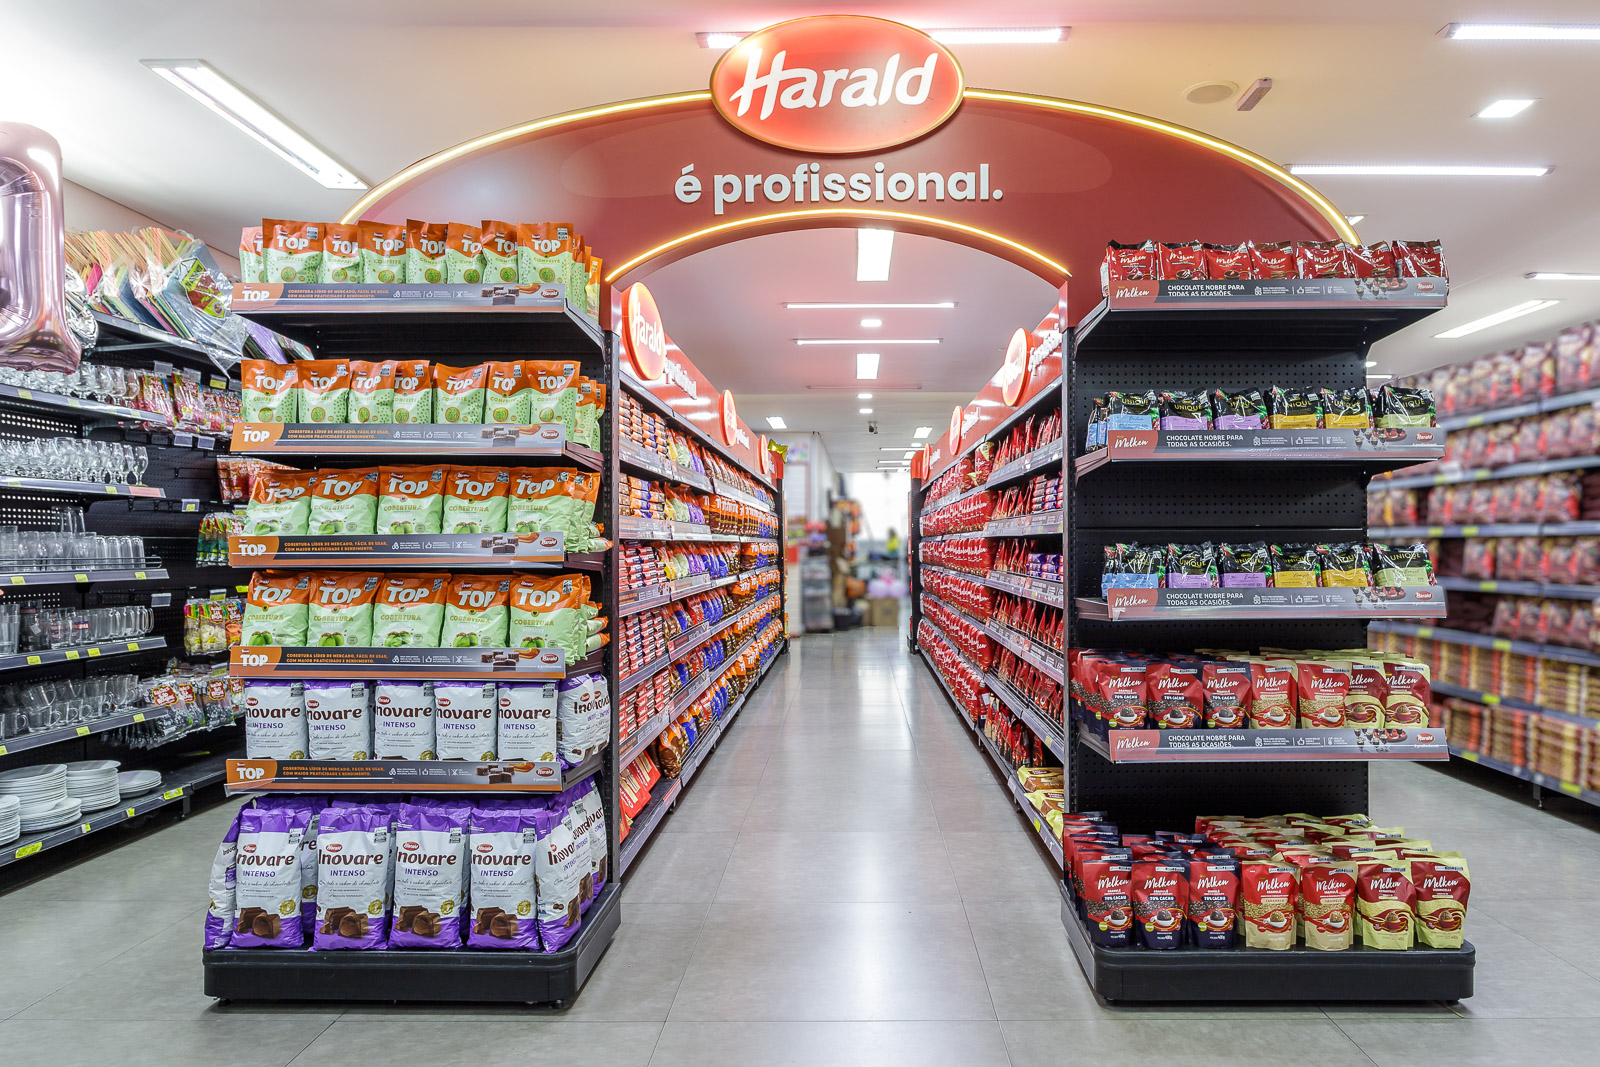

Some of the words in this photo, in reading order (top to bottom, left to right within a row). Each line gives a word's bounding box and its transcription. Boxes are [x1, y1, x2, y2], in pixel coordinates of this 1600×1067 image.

[729, 48, 938, 120] Harald
[675, 163, 701, 203] é
[714, 161, 1003, 215] profissional.
[276, 235, 309, 251] TOP
[372, 238, 405, 251] TOP
[531, 239, 561, 253] TOP
[241, 290, 270, 302] TOP
[1116, 287, 1149, 299] Melken
[254, 376, 286, 391] TOP
[310, 376, 337, 389] TOP
[355, 375, 382, 389] TOP
[394, 377, 419, 390] TOP
[446, 378, 474, 391] TOP
[492, 376, 516, 391] TOP
[538, 376, 567, 390] TOP
[242, 430, 270, 442] TOP
[1115, 436, 1149, 448] Melken
[321, 479, 363, 496] TOP
[388, 478, 429, 494] TOP
[454, 479, 495, 497] TOP
[516, 478, 555, 495] TOP
[265, 486, 306, 502] TOP
[448, 505, 489, 513] COBERTURA
[238, 544, 267, 557] TOP
[1390, 552, 1420, 561] UNIQUE
[252, 585, 292, 602] TOP
[319, 586, 361, 604] TOP
[386, 586, 430, 603] TOP
[458, 590, 496, 608] TOP
[517, 588, 560, 607] TOP
[1114, 595, 1148, 607] Melken
[240, 654, 269, 667] TOP
[1109, 676, 1142, 689] Melken
[1158, 676, 1189, 689] Melken
[1207, 676, 1239, 690] Melken
[1256, 675, 1288, 689] Melken
[1311, 677, 1344, 690] Melken
[246, 706, 301, 719] novare
[307, 708, 363, 721] novare
[376, 705, 432, 718] novare
[436, 707, 492, 719] novare
[499, 707, 551, 719] novare
[1116, 737, 1150, 749] Melken
[1201, 740, 1234, 748] OCASIÕES.
[236, 768, 265, 779] TOP
[318, 849, 384, 865] Inovare
[330, 869, 366, 877] INTENSO
[405, 868, 439, 877] INTENSO
[1097, 875, 1129, 890] Melken
[1144, 875, 1177, 890] Melken
[1197, 875, 1229, 889] Melken
[1257, 878, 1290, 892] Melken
[1316, 879, 1347, 892] Melken
[1370, 877, 1401, 890] Melken
[1423, 876, 1459, 889] Melken
